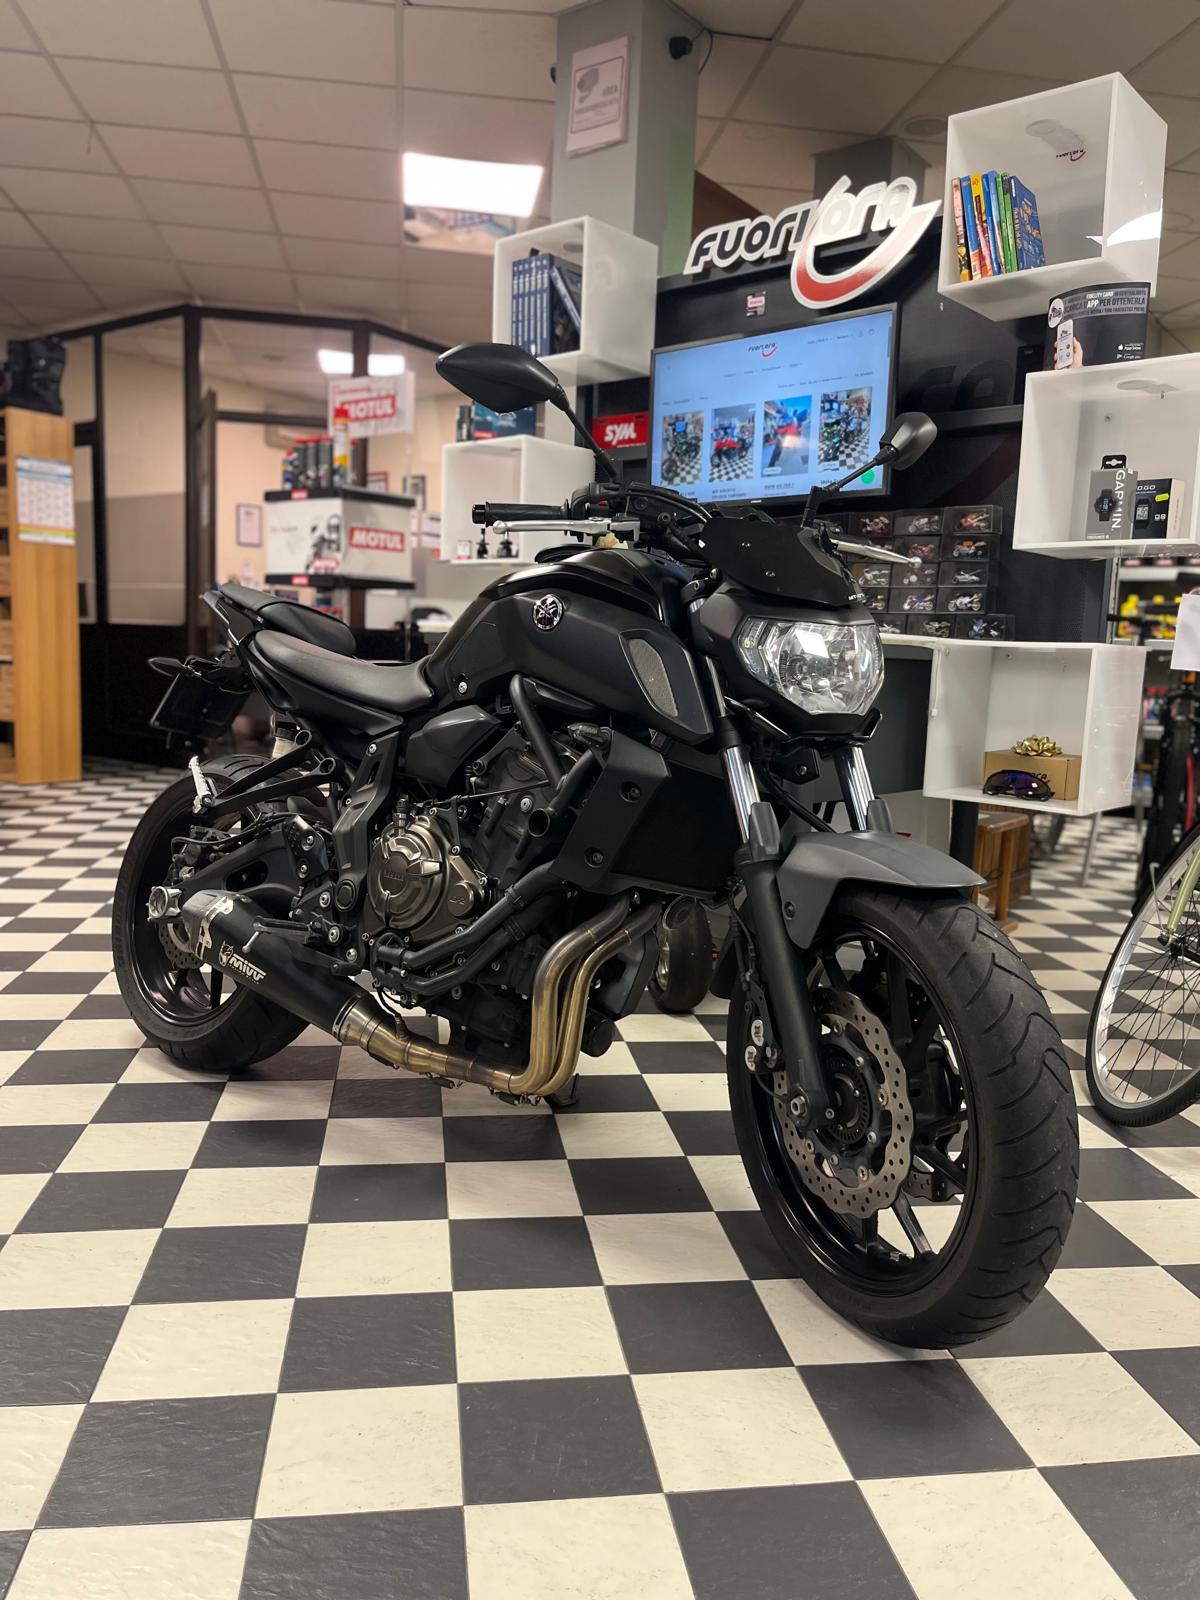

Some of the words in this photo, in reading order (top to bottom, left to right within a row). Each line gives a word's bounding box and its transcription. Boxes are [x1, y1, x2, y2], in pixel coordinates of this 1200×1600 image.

[1099, 298, 1111, 307] PER
[604, 422, 637, 445] SYM
[352, 530, 402, 549] MOTUL
